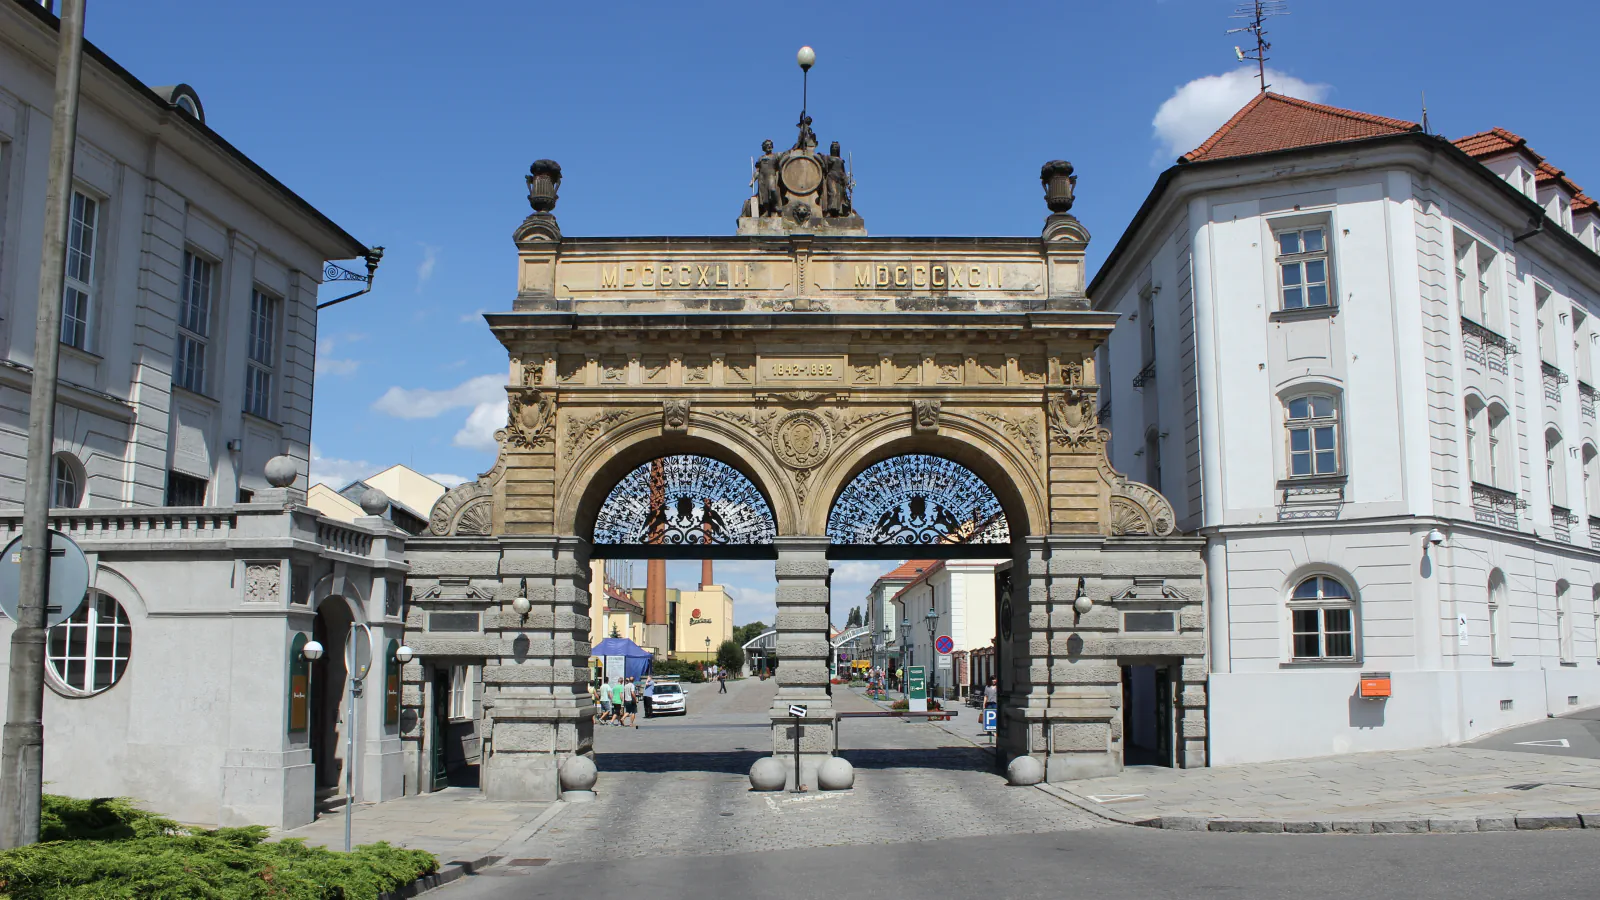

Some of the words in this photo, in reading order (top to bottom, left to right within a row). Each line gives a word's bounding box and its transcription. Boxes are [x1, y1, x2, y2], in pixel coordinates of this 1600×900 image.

[601, 265, 750, 288] MDCCCXLII
[854, 265, 1002, 288] MDCCCXCII
[771, 363, 833, 377] 1842-1892
[986, 710, 996, 725] P
